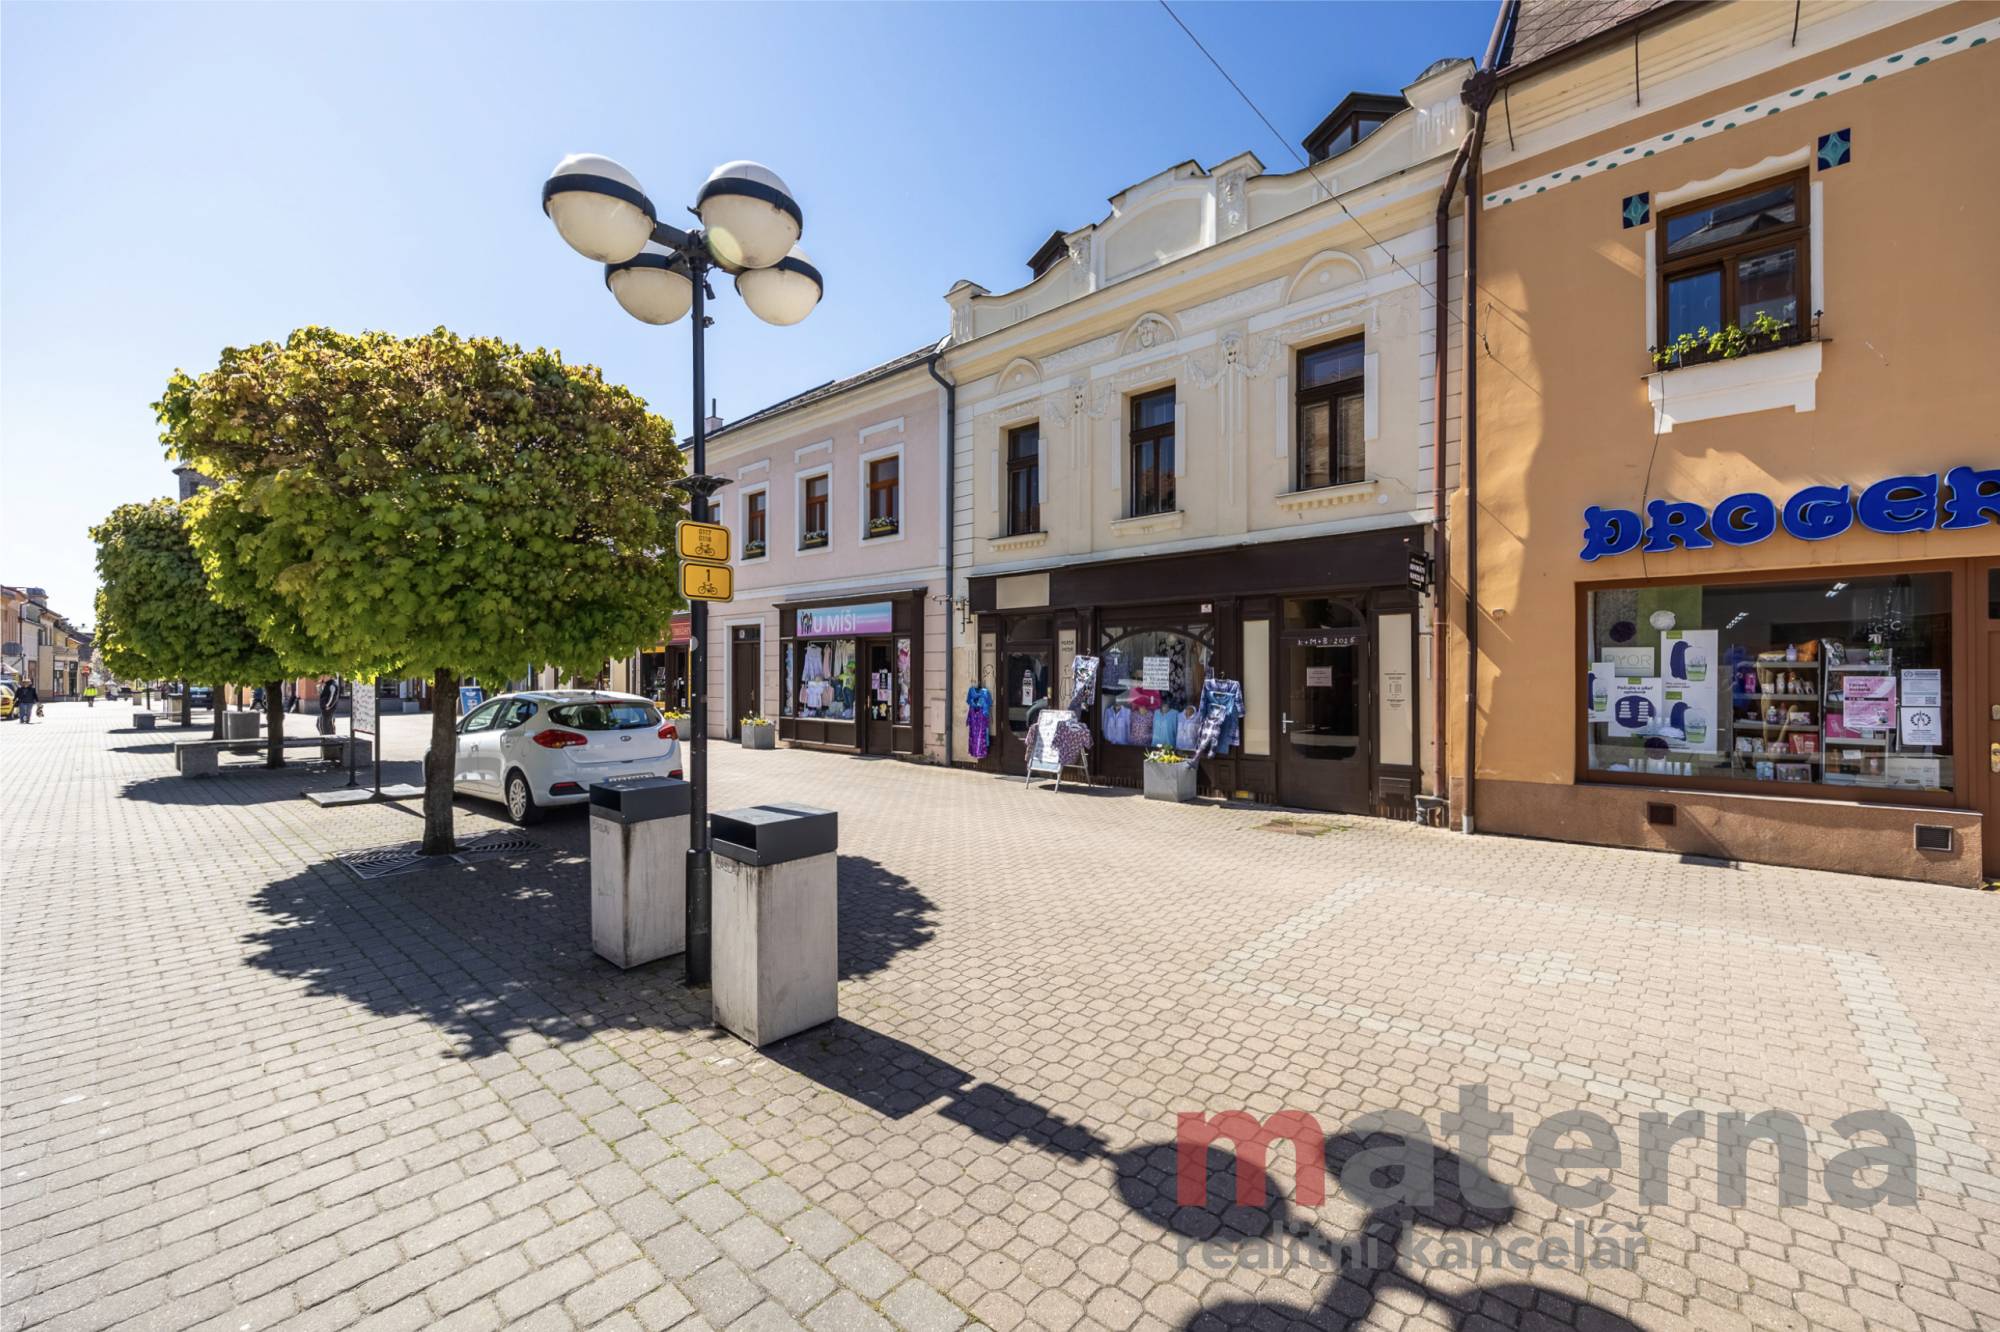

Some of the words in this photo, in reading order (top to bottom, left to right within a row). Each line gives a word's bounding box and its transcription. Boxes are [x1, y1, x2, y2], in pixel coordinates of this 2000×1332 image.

[706, 569, 711, 582] 1
[813, 615, 823, 633] U
[826, 609, 856, 633] MÍŠI
